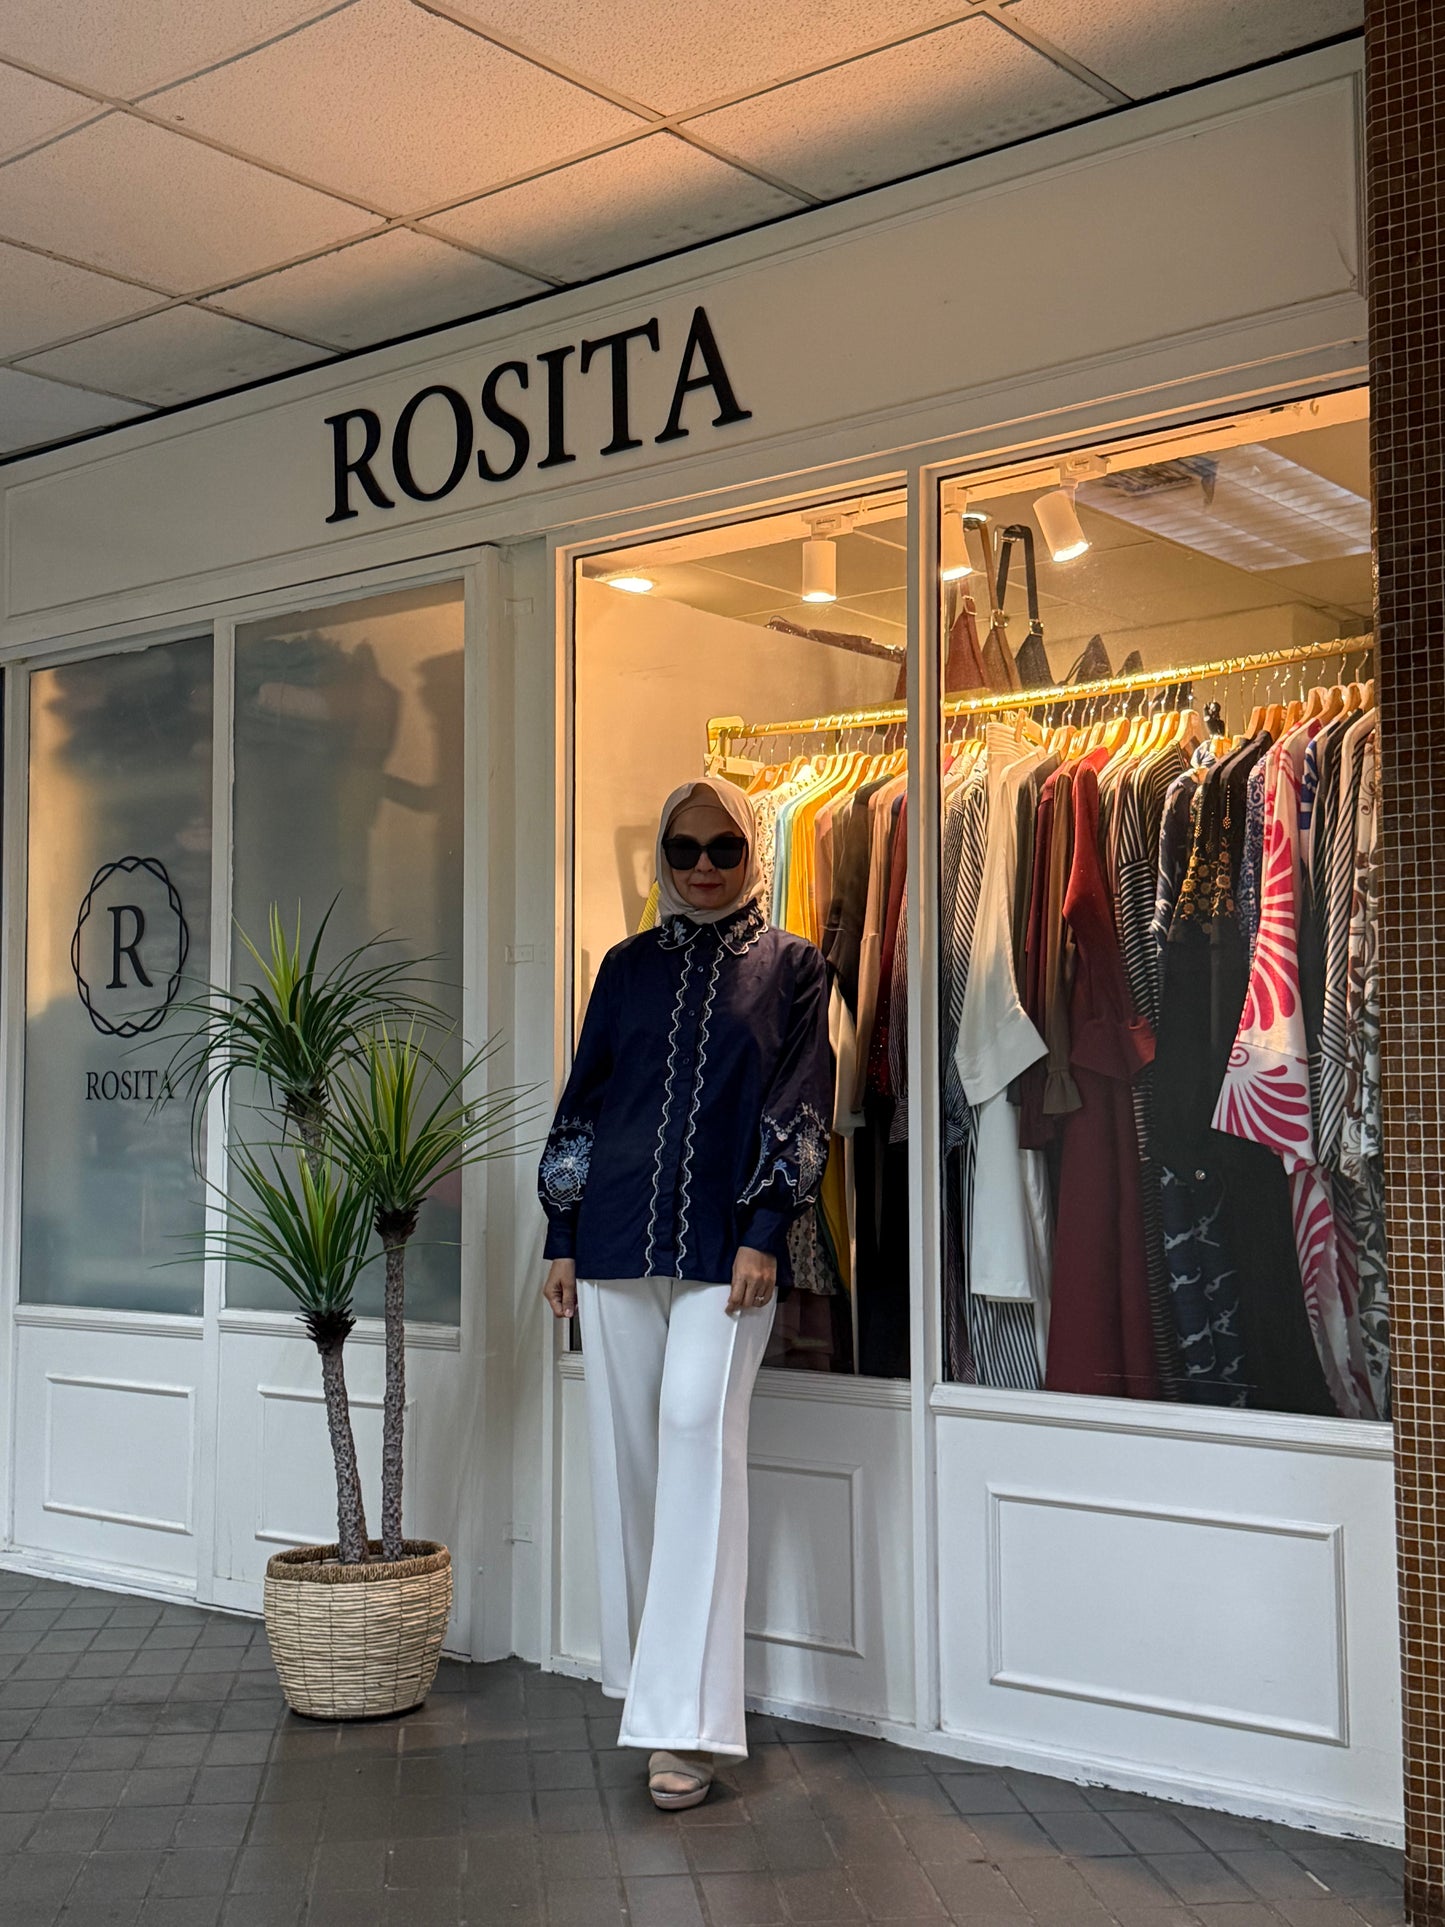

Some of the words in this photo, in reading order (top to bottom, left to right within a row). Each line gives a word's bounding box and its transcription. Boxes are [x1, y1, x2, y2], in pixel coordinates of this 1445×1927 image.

[324, 306, 752, 523] ROSITA
[106, 905, 153, 989] R
[86, 1070, 174, 1100] ROSITA
